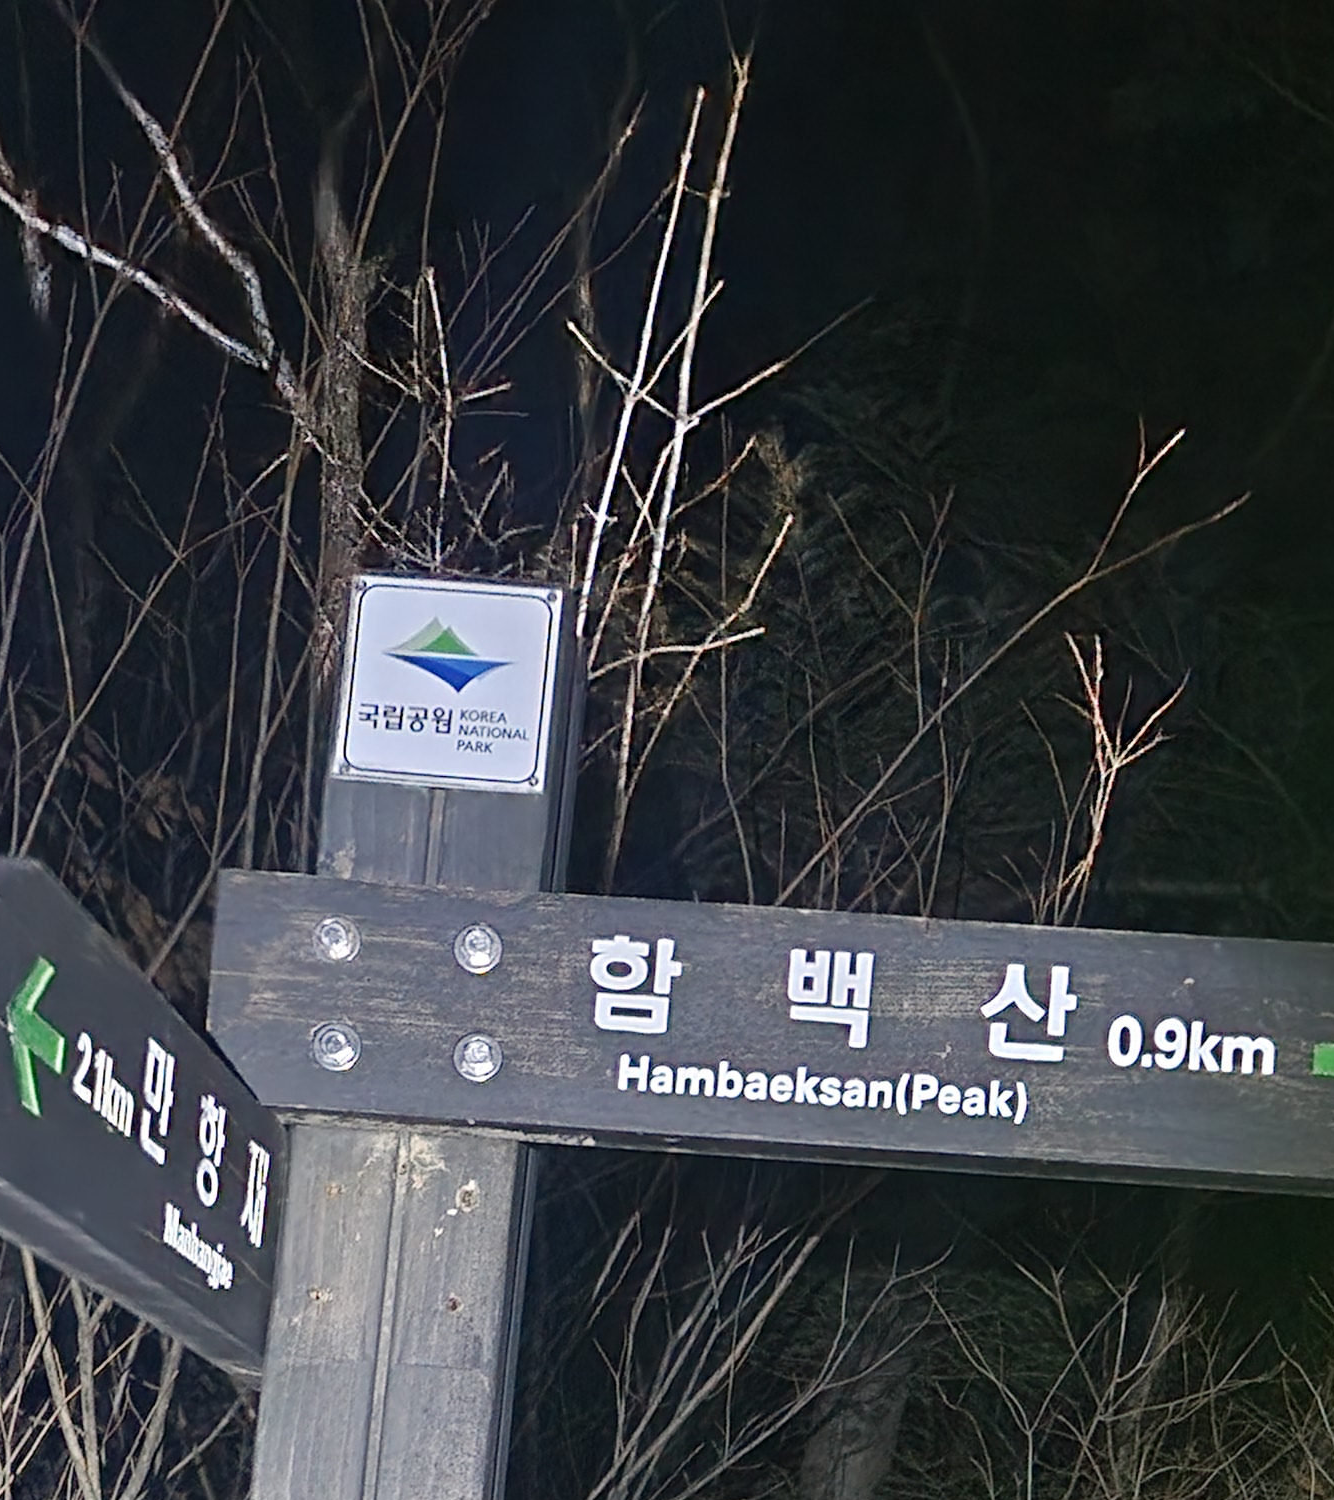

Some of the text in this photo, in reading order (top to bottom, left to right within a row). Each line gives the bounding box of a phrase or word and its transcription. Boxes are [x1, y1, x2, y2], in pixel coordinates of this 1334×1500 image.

[358, 703, 453, 734] 국립공원
[460, 709, 507, 724] KOREA
[458, 724, 530, 741] NATIONAL
[456, 740, 492, 754] PARK
[1107, 1014, 1276, 1076] 0.9km
[617, 1053, 1028, 1125] Hambaeksan(Peak)
